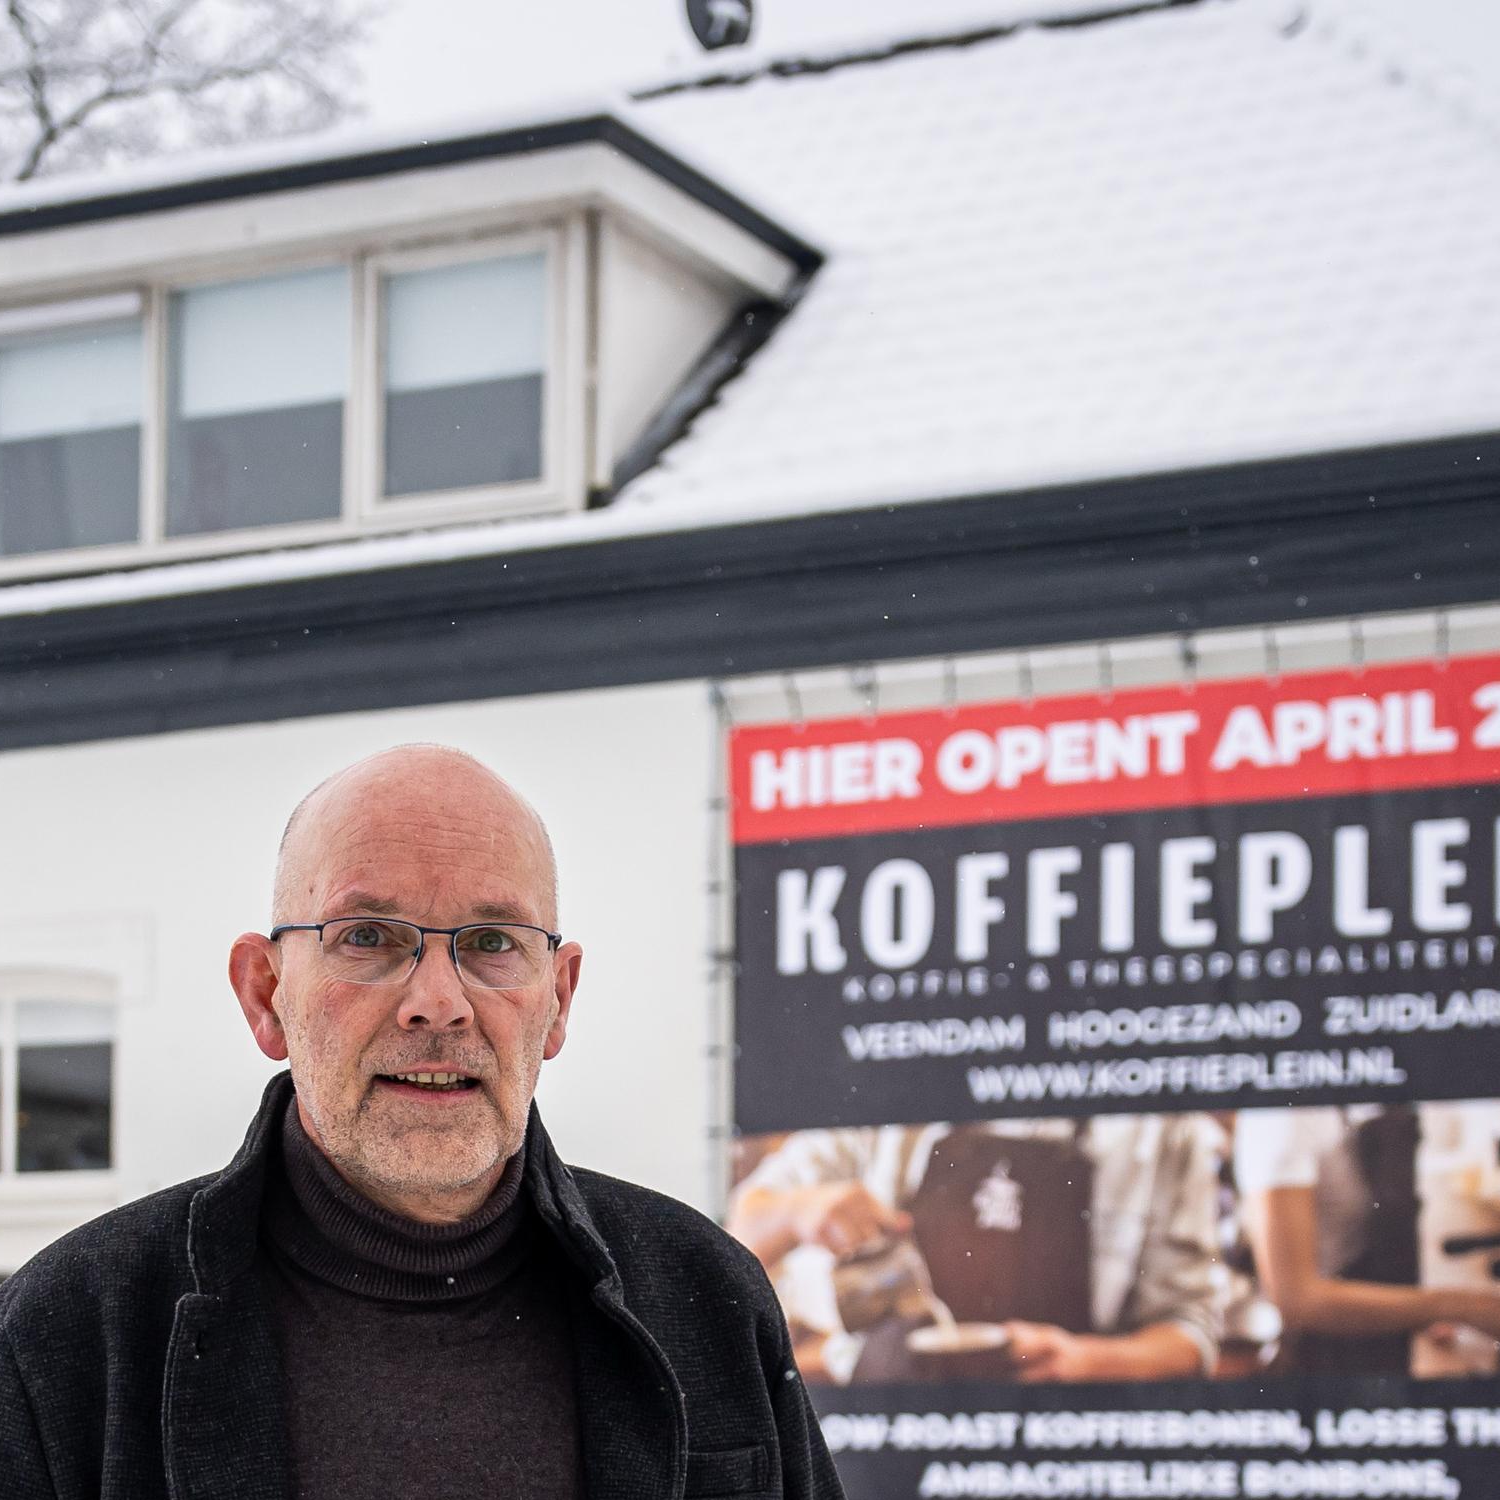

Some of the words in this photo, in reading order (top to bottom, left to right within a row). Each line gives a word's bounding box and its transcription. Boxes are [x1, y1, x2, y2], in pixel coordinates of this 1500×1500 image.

[750, 738, 922, 812] HIER
[936, 710, 1198, 794] OPENT
[1210, 690, 1459, 771] APRIL
[842, 1014, 1026, 1061] VEENDAM
[1048, 999, 1302, 1050] HOOGEZAND
[967, 1045, 1406, 1102] WWW.KOFFIEPLEIN.NL
[819, 1411, 1020, 1450] OW-ROAST
[1024, 1408, 1313, 1453] KOFFIEBONEN,
[1316, 1407, 1448, 1448] LOSSE
[919, 1461, 1241, 1499] AMBACHTELIJKE
